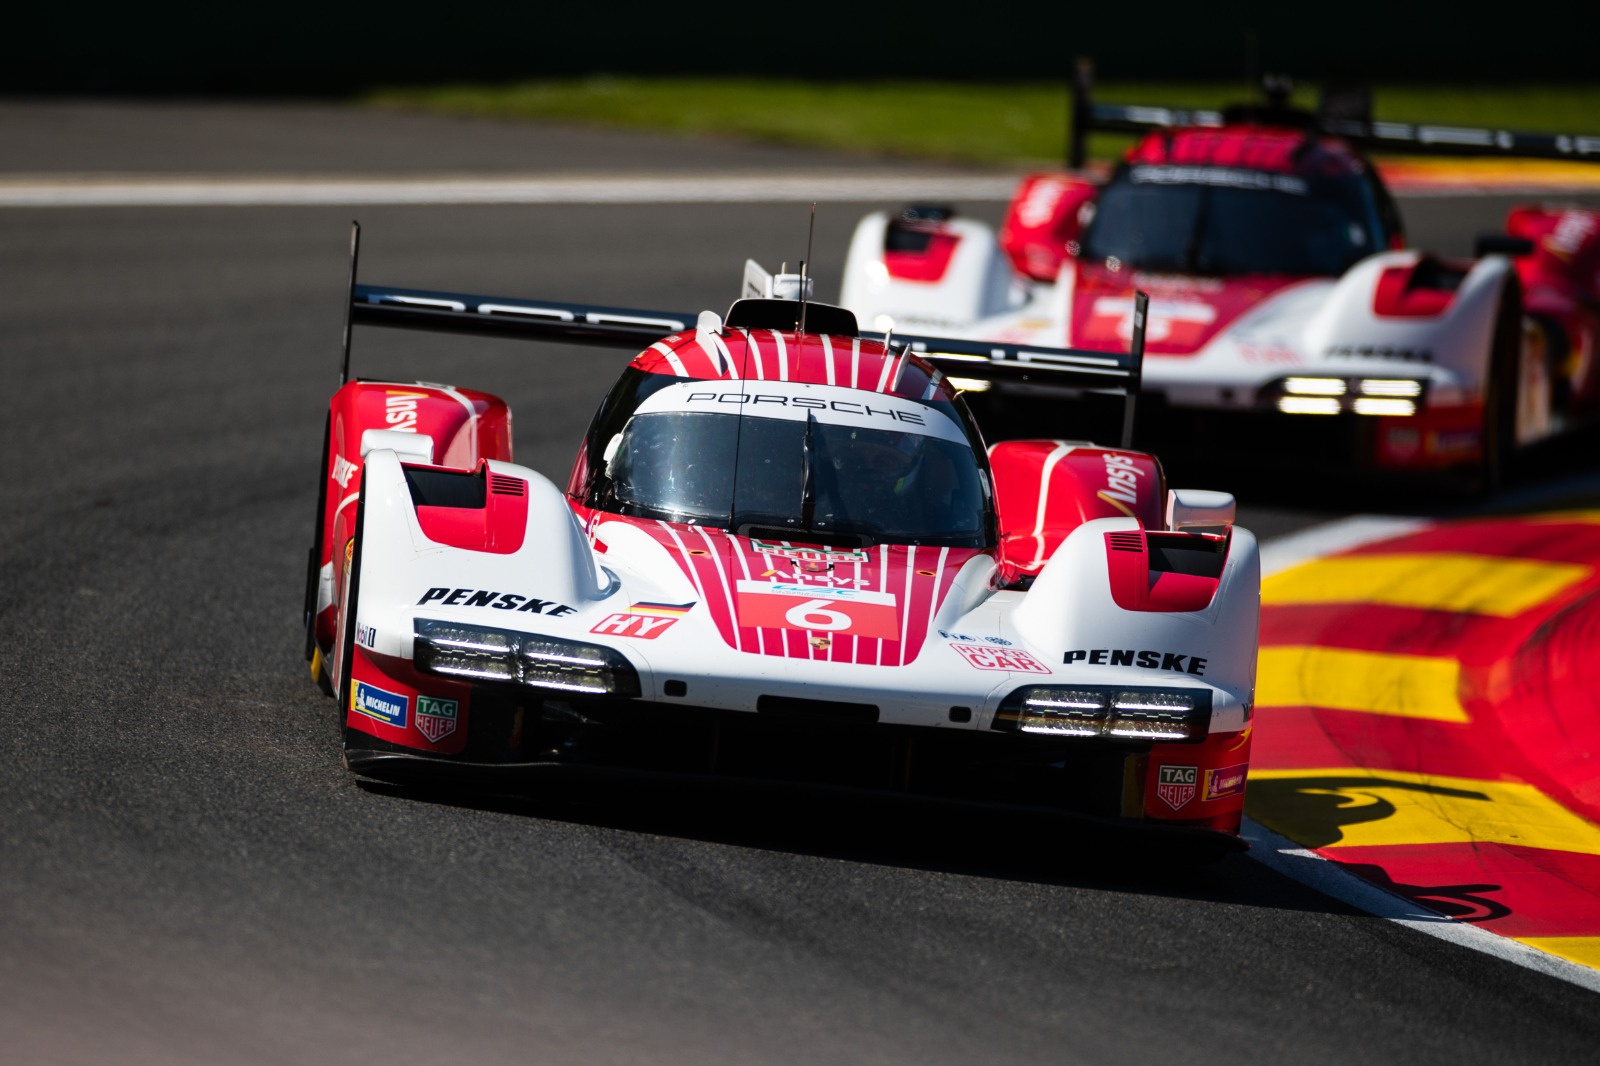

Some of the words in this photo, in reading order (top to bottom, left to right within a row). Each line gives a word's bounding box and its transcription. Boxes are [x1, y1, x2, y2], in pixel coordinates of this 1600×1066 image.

[385, 390, 429, 433] Ansy
[687, 393, 925, 426] PORSCHE
[1097, 452, 1145, 517] Ansys
[760, 569, 871, 586] Ansys
[416, 587, 578, 618] PENSKE
[593, 614, 675, 637] HY
[785, 599, 852, 631] 6
[957, 645, 1029, 659] HYPER
[969, 653, 1044, 672] CAR
[1063, 649, 1208, 676] PENSKE
[365, 695, 401, 717] MICHELIN
[420, 699, 454, 716] TAG
[417, 716, 454, 739] HEUER
[1163, 768, 1195, 783] TAG
[1160, 785, 1194, 807] HEUER
